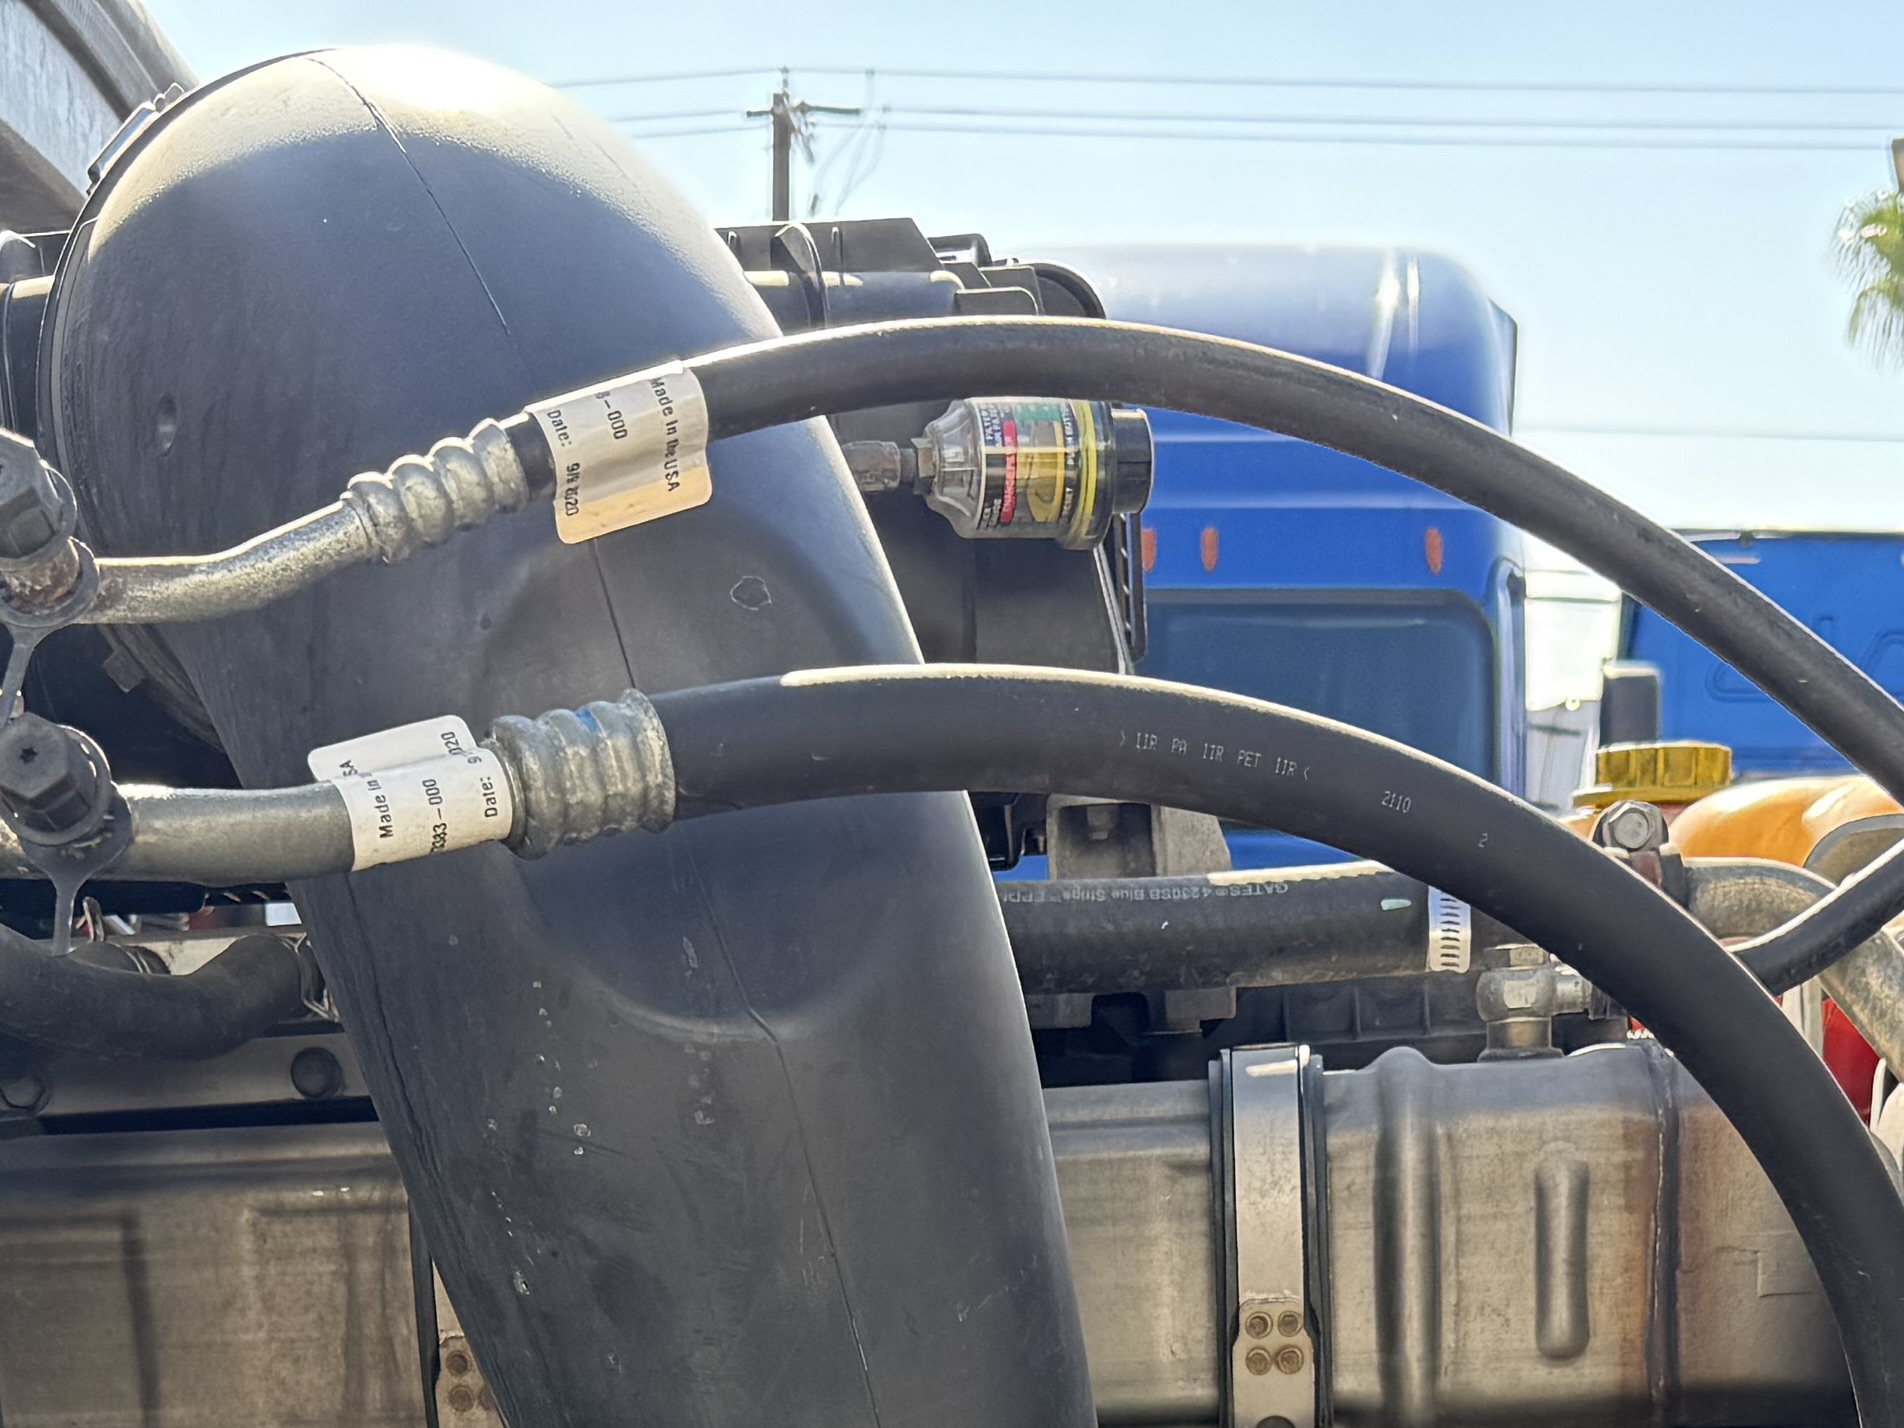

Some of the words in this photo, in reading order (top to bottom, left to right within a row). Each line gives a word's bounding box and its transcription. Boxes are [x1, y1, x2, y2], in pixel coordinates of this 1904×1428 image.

[546, 409, 573, 448] Date:
[664, 459, 681, 492] USA
[1237, 749, 1264, 769] PET
[480, 776, 499, 818] Date:
[1381, 790, 1412, 815] 2110
[374, 794, 395, 839] Made
[1111, 887, 1144, 902] Blue
